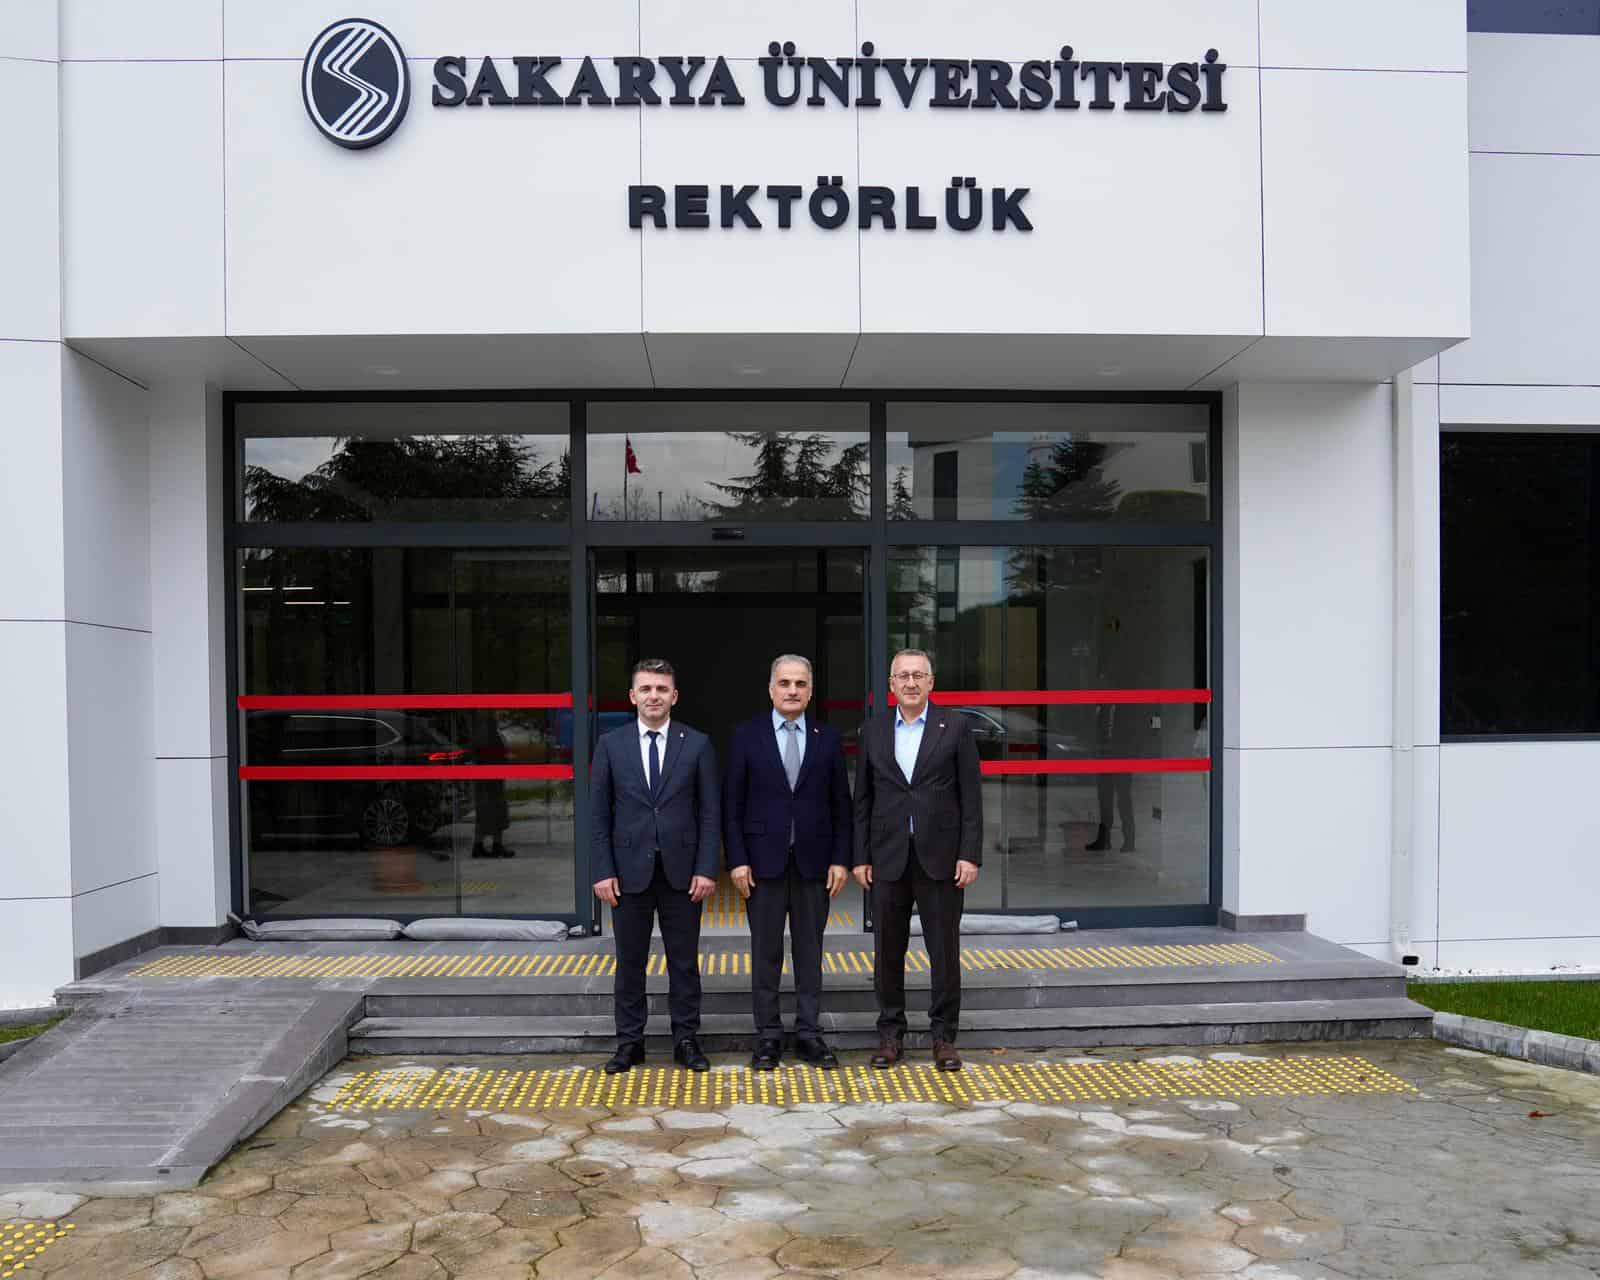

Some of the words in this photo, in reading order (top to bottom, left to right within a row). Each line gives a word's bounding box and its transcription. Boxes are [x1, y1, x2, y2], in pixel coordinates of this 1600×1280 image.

[432, 55, 746, 109] SAKARYA
[758, 41, 1228, 113] ÜNİVERSİTESİ
[628, 175, 1035, 233] REKTÖRLÜK
